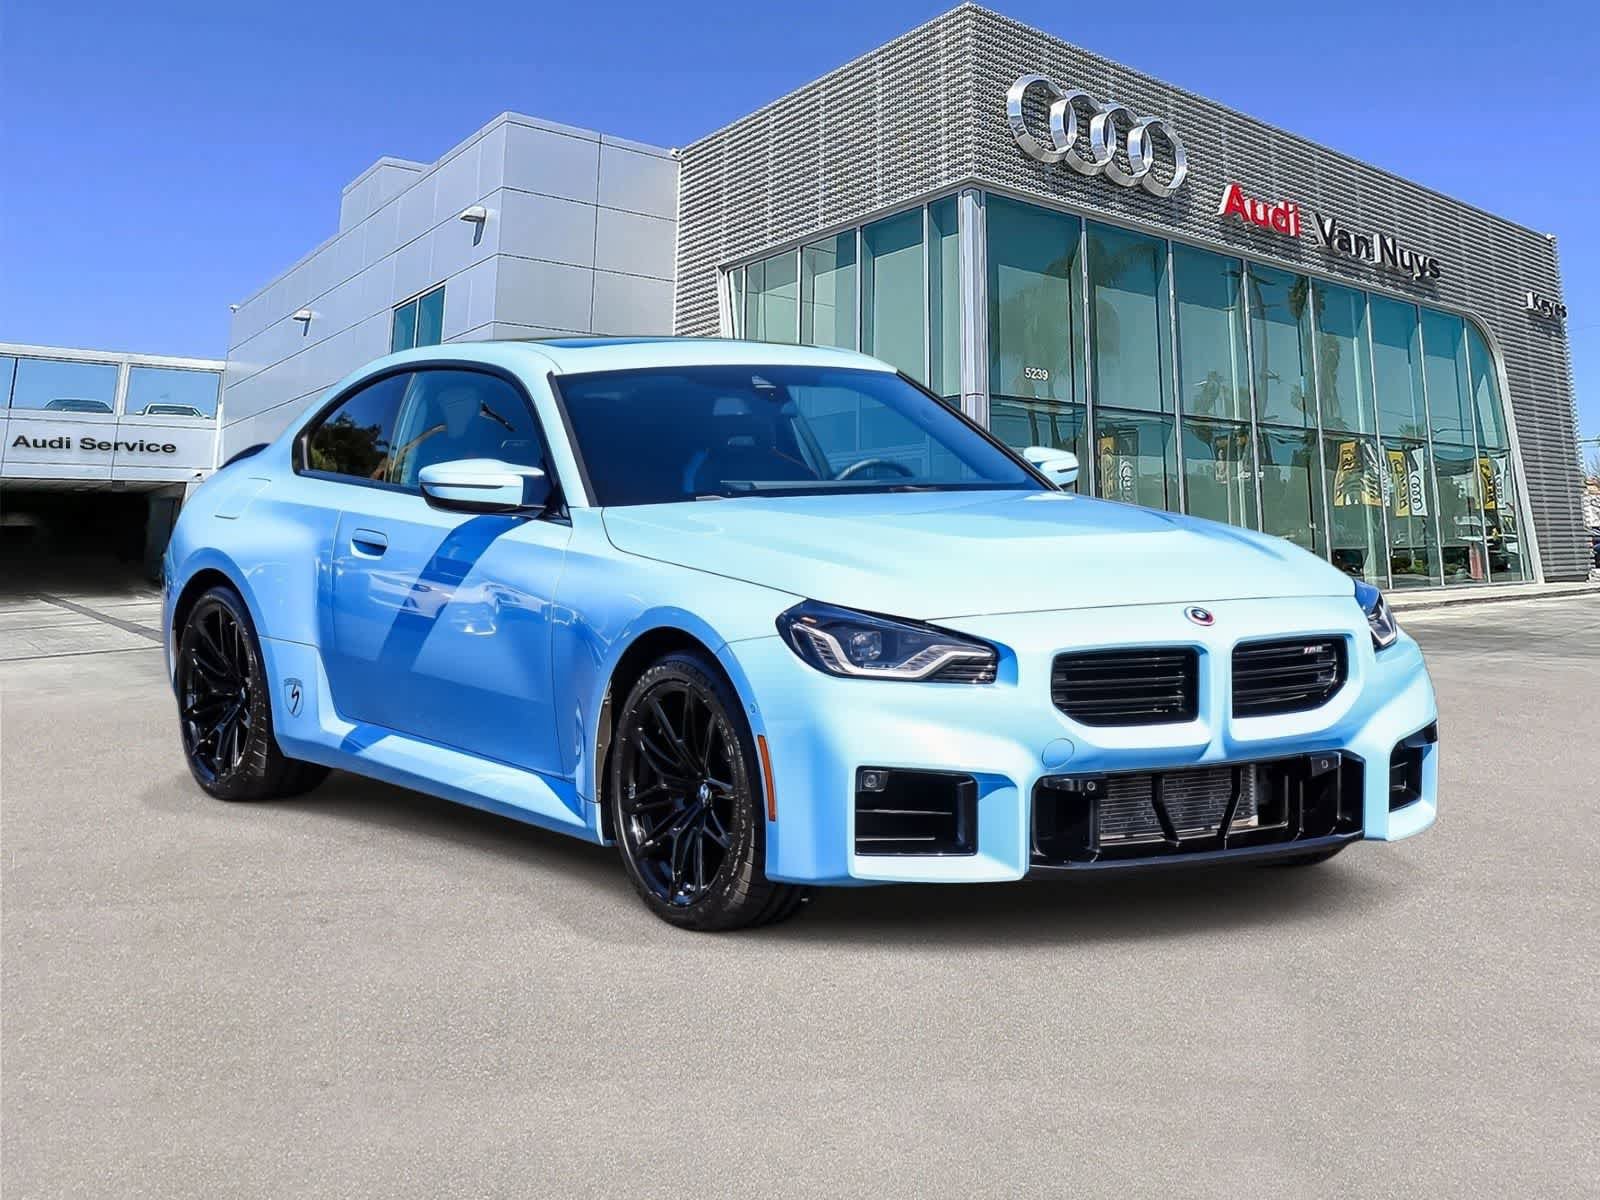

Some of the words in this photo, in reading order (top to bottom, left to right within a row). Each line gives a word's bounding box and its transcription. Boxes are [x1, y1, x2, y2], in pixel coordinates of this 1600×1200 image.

[1217, 183, 1301, 238] Audi
[1311, 213, 1371, 258] Van
[1374, 233, 1441, 281] Nuys
[1024, 367, 1049, 381] 5239
[12, 434, 71, 449] Audi
[79, 436, 177, 454] Service
